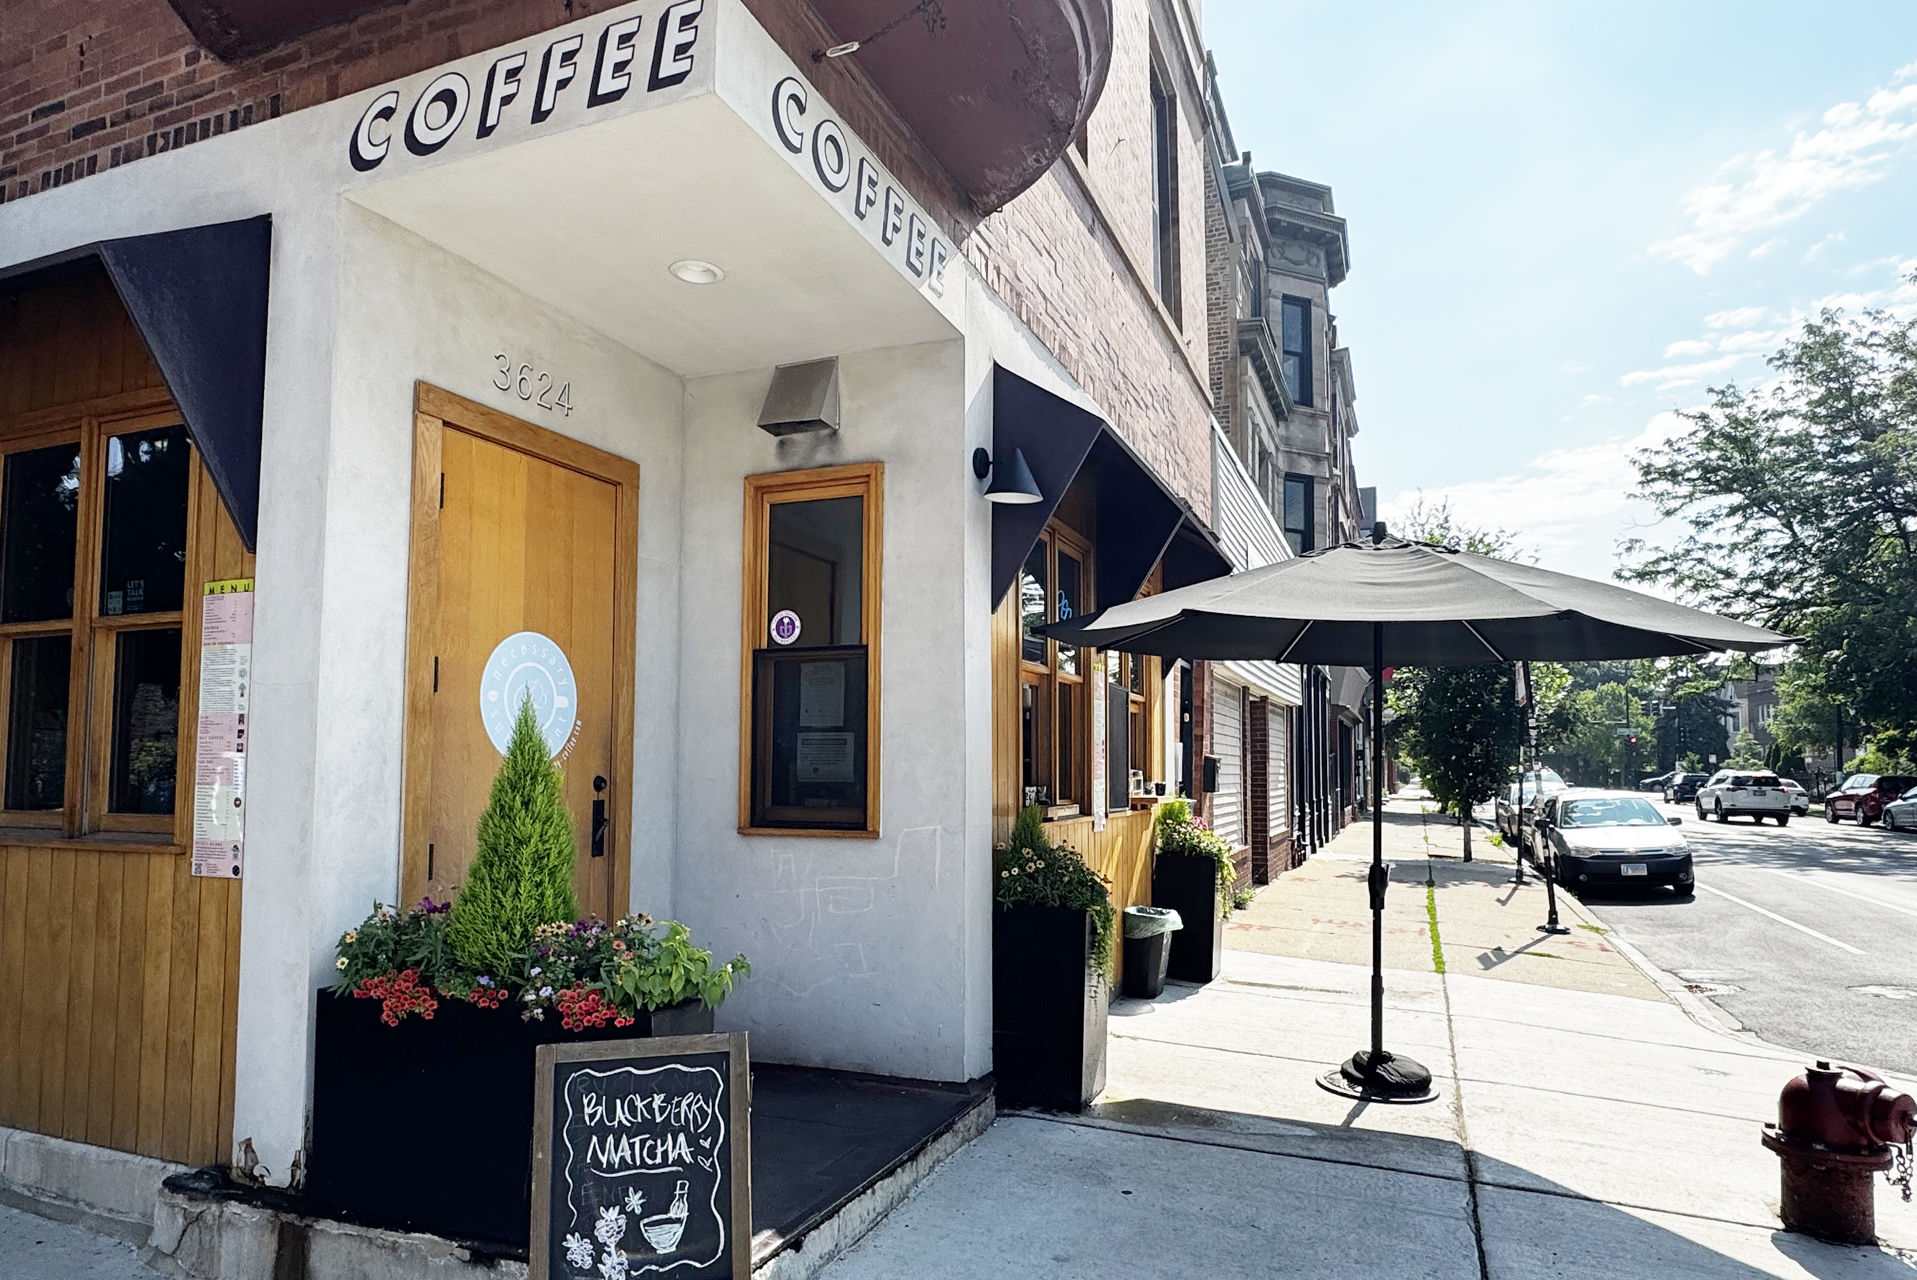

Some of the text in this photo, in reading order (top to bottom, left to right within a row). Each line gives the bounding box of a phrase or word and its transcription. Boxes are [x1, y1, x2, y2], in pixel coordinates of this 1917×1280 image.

[349, 0, 703, 172] COFFEE
[772, 77, 947, 299] COFFEE
[493, 352, 573, 417] 3624
[127, 588, 144, 596] TALK
[208, 583, 251, 595] MENU
[492, 643, 569, 686] necessary
[582, 1091, 713, 1134] BLACKBERRY
[587, 1132, 695, 1169] MATCHA
